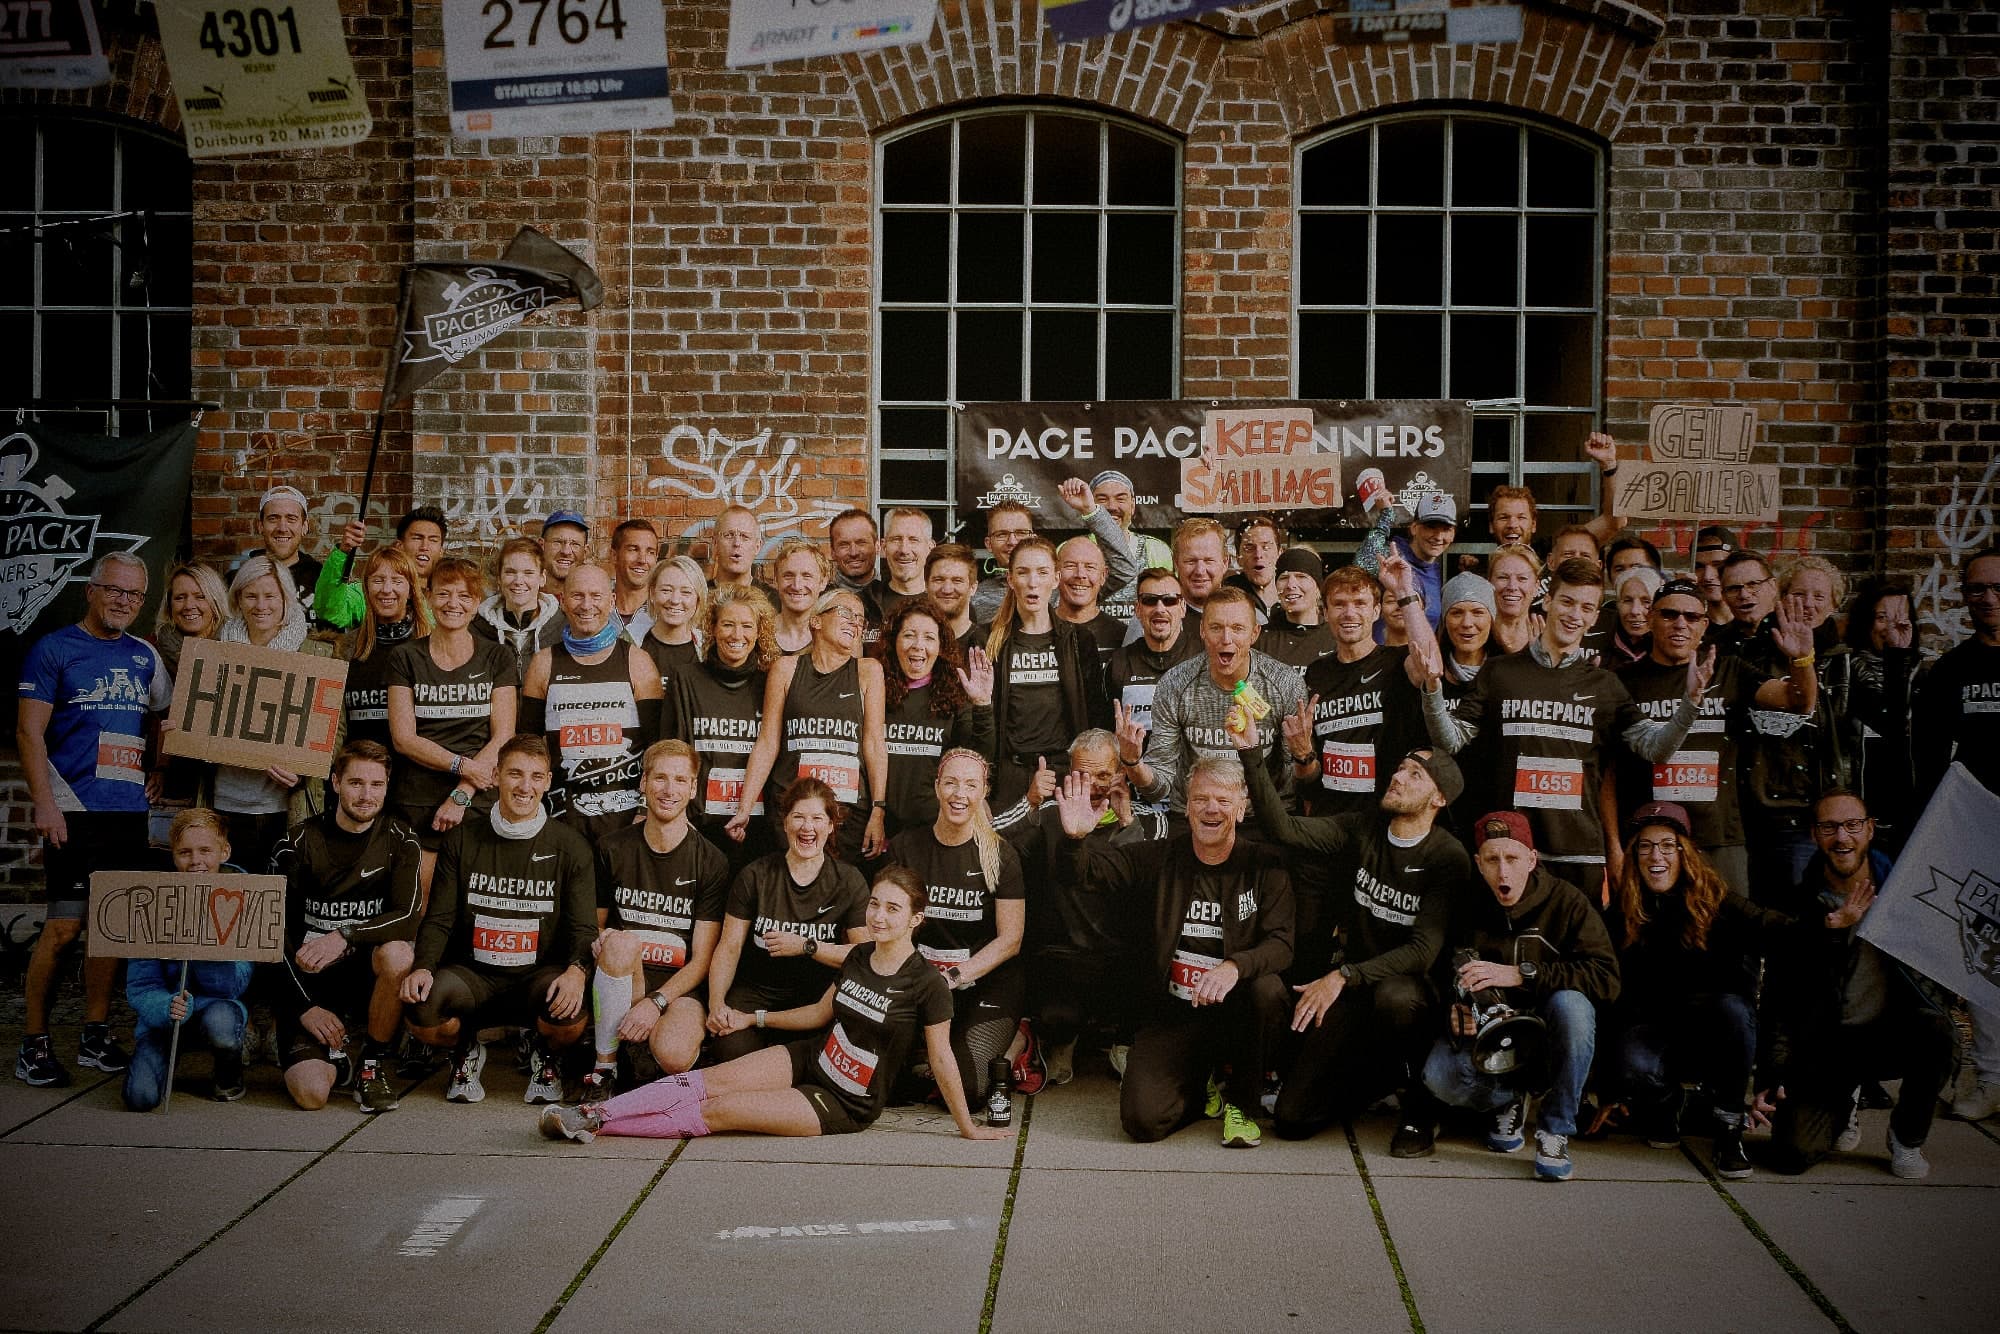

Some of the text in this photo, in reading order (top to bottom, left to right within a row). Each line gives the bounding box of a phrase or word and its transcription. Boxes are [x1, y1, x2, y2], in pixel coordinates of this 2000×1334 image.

[200, 8, 302, 58] 4301
[481, 0, 628, 49] 2764
[194, 124, 368, 150] Duisburg 20. Mai 2012
[435, 292, 537, 338] PACE PACK
[986, 427, 1095, 461] PACE
[1215, 417, 1314, 457] KEEP
[1654, 407, 1753, 463] GEIL!
[1135, 494, 1159, 506] RUN
[1186, 466, 1336, 508] SMILING
[1619, 469, 1776, 517] #BALLERN
[5, 522, 87, 552] PACK
[80, 703, 96, 712] Hier
[1501, 699, 1597, 727] #PACEPACK
[566, 727, 617, 745] 2:15 h
[787, 716, 859, 739] #PACEPACK
[1326, 757, 1369, 776] 1:30 h
[1528, 773, 1573, 792] 1655
[468, 871, 557, 898] #PACEPACK
[304, 897, 385, 919] #PACEPACK
[614, 885, 694, 916] #PACEPACK
[480, 932, 532, 951] 1:45 h
[840, 978, 893, 1013] #PACEPACK
[830, 1043, 859, 1080] 1654
